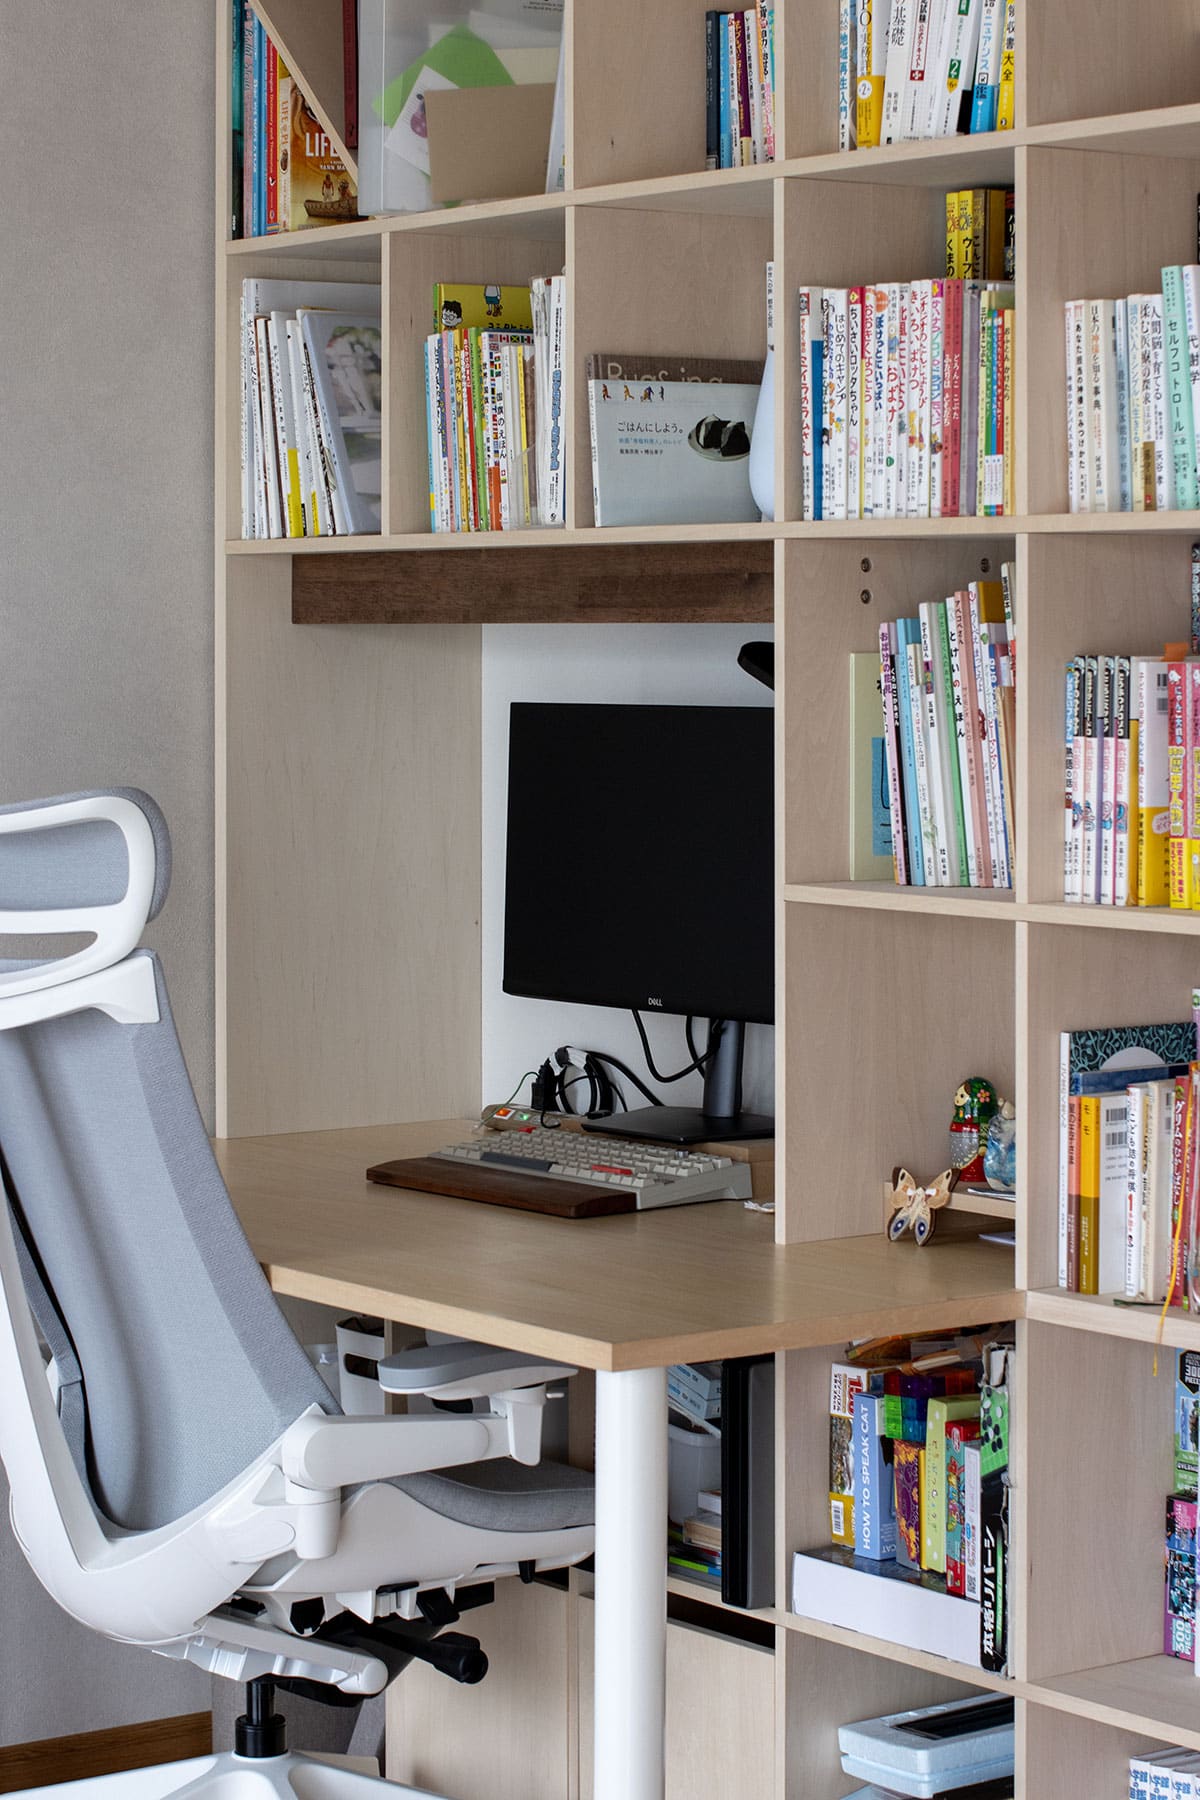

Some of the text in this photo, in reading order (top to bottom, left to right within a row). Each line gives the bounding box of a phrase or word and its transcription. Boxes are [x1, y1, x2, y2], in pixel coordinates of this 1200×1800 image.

[281, 101, 289, 121] LIFE
[839, 32, 849, 120] 地域再生入門
[281, 133, 289, 145] PI
[962, 237, 973, 280] ウーフ
[835, 314, 847, 405] はじめてのキャンプ
[849, 307, 859, 426] ちいさいロッタちゃん
[1167, 320, 1185, 435] セルフコントロール
[496, 392, 507, 459] 国旗のえほん
[617, 421, 684, 434] ごはんにしよう。
[950, 631, 965, 738] とけいのえほん
[648, 997, 663, 1007] DELL
[860, 1403, 870, 1550] HOW TO SPEAK CAT
[982, 1525, 996, 1656] 本格リバーシ
